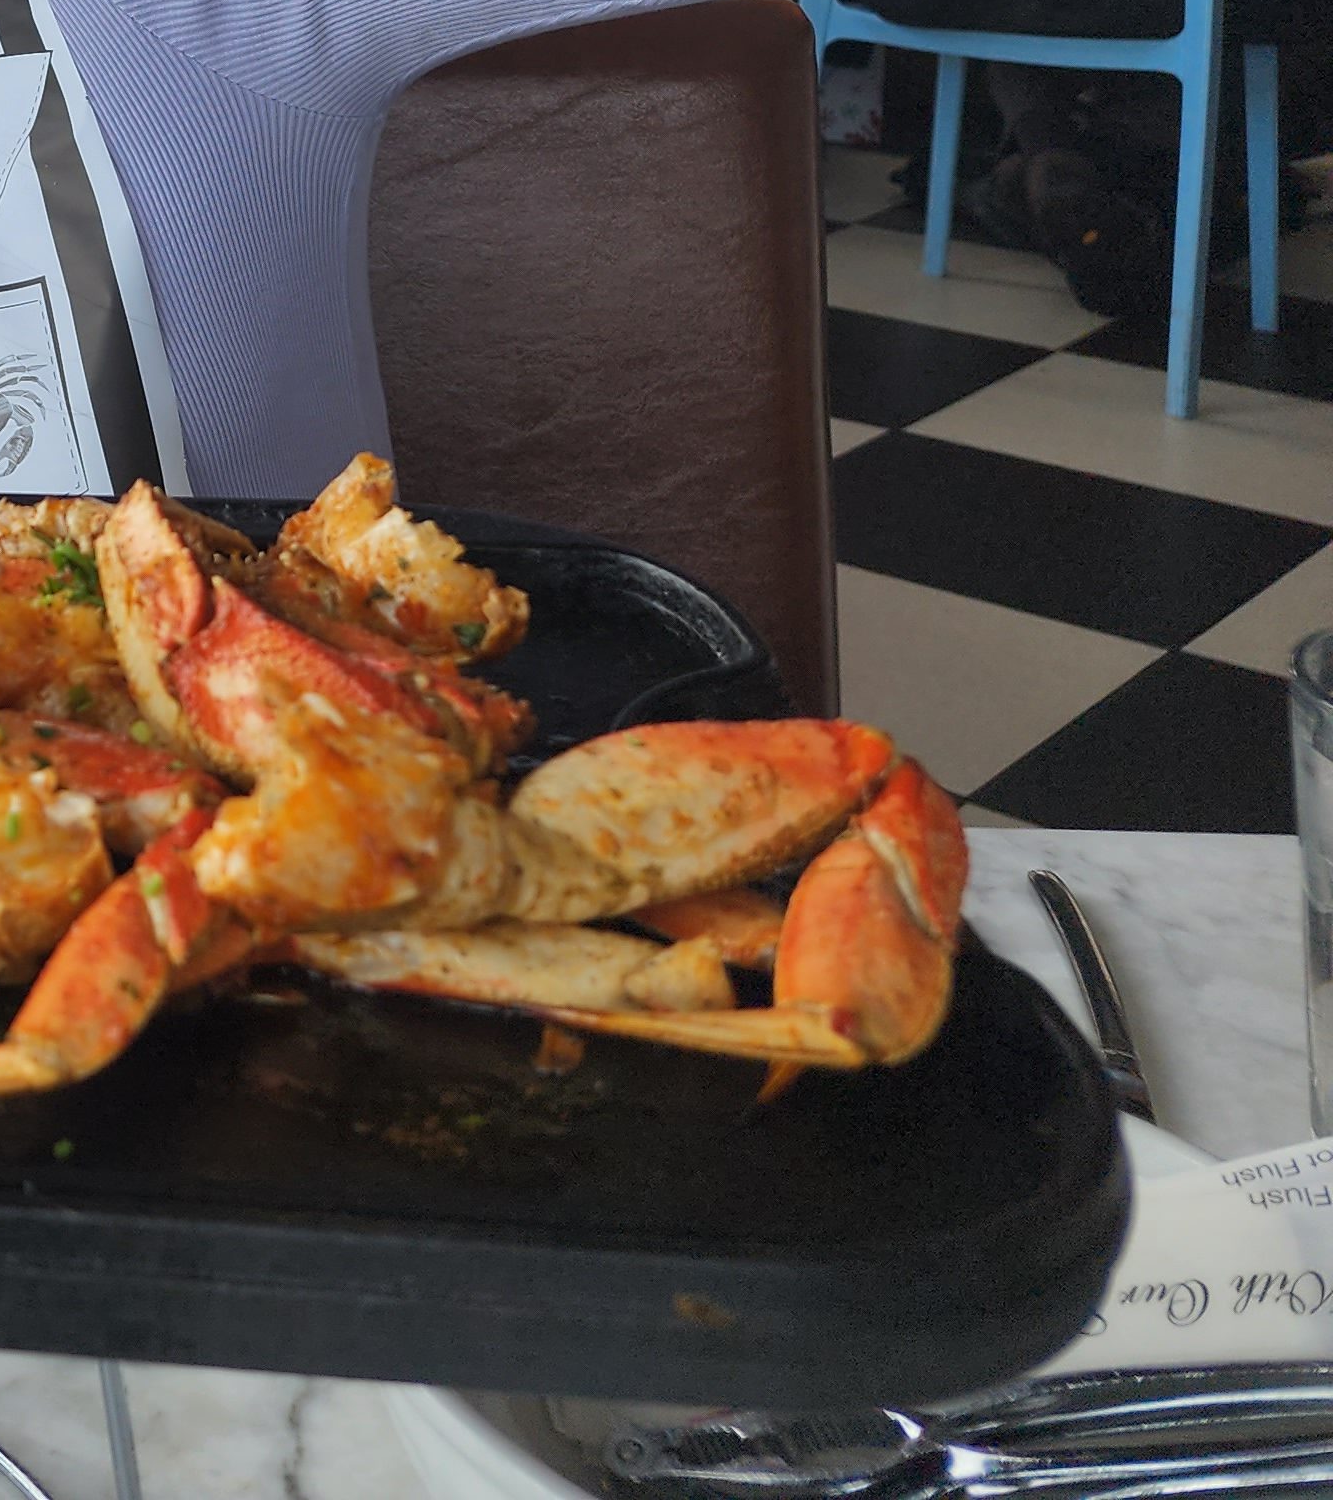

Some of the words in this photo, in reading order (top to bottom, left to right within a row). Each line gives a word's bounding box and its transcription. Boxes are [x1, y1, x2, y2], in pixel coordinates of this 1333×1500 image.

[1306, 1148, 1333, 1168] ot
[1221, 1157, 1301, 1188] Flush
[1248, 1185, 1333, 1210] Flush
[1120, 1278, 1211, 1327] Our
